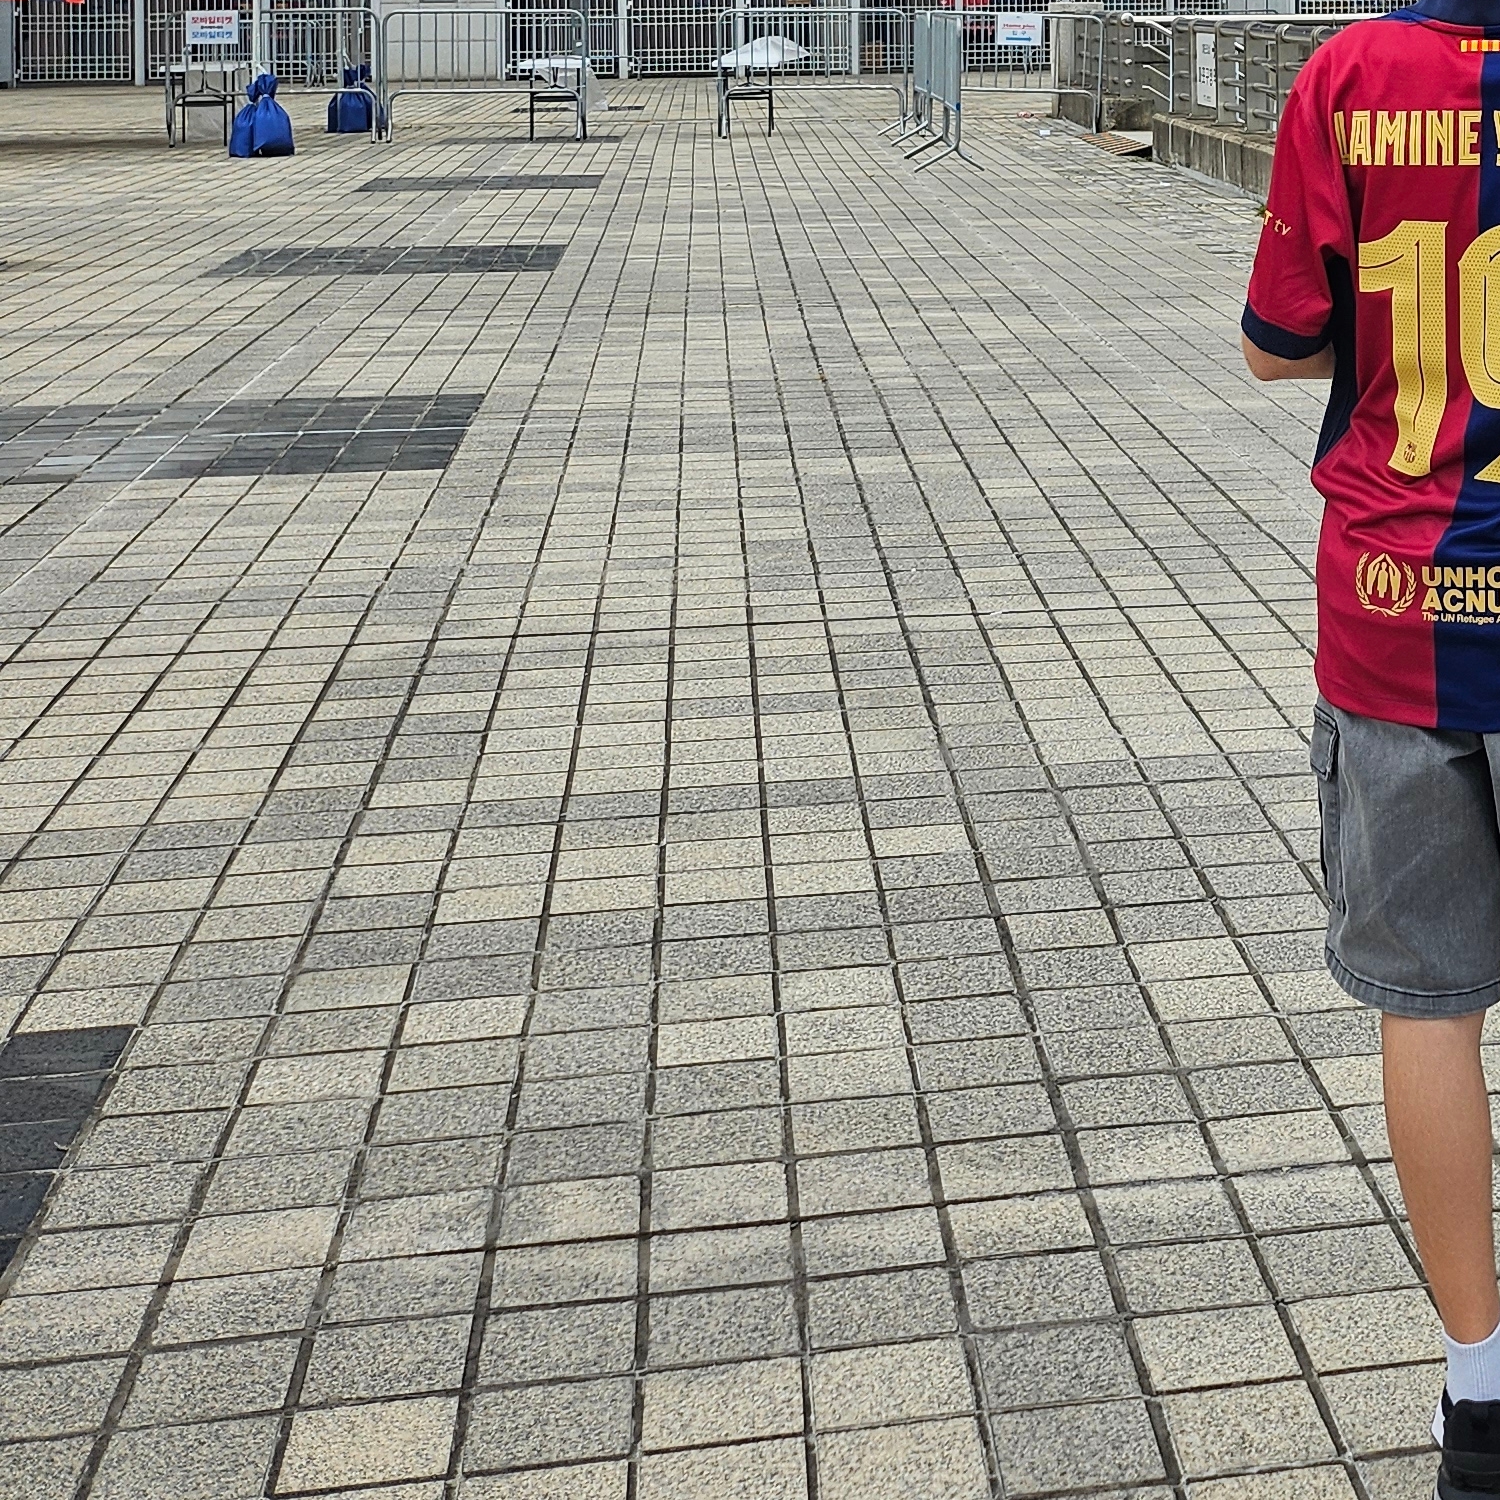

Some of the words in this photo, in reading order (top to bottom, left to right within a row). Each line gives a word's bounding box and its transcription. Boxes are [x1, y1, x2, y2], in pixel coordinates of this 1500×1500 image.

[1333, 109, 1482, 167] LAMINE
[1422, 611, 1439, 623] The
[1440, 613, 1455, 623] UN
[1456, 613, 1495, 626] Refugee
